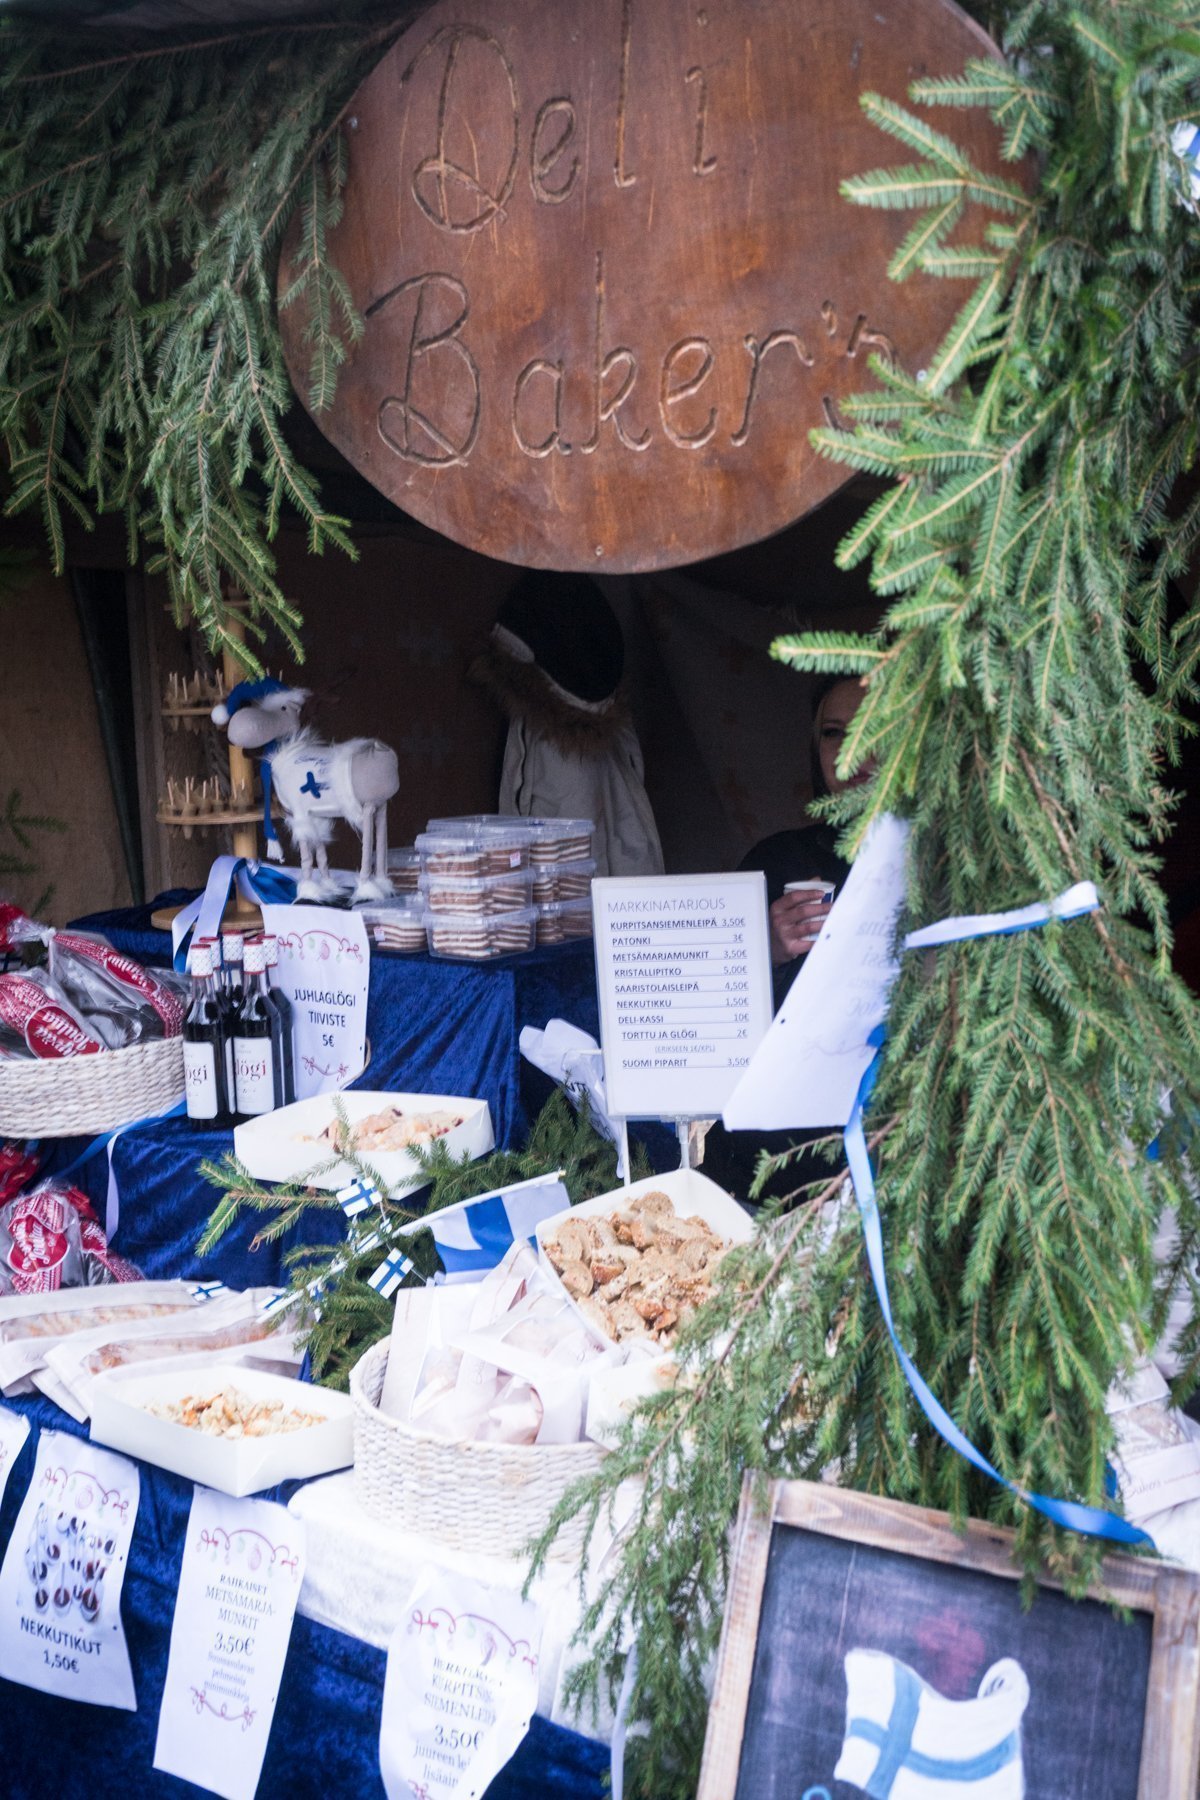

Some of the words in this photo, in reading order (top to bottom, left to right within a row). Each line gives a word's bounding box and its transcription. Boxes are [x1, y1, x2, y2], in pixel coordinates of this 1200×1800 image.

[400, 0, 717, 234] Deli
[607, 898, 726, 913] MARKKINATARJOUS
[610, 917, 718, 930] KURPITSANSIEMENLEIPÄ
[722, 917, 745, 928] 3,50€
[612, 936, 650, 946] PATONKI
[732, 934, 744, 943] 3€
[612, 950, 710, 961] METSÄMARJAMUNKIT
[723, 949, 748, 960] 3,50€
[614, 967, 682, 977] KRISTALLIPITKO
[723, 965, 748, 976] 5,00€
[614, 981, 700, 993] SAARISTOLAISLEIPÄ
[725, 981, 748, 992] 4,50€
[294, 989, 356, 1007] JUHLAGLÖGI
[616, 999, 672, 1009] NEKKUTIKKU
[726, 998, 749, 1008] 1,50€
[308, 1010, 346, 1028] TIIVISTE
[618, 1014, 664, 1024] DELI-KASSI
[734, 1012, 750, 1022] 10€
[322, 1034, 334, 1047] 5€
[622, 1030, 656, 1040] TORTTU
[658, 1030, 668, 1040] JA
[670, 1028, 698, 1039] GLÖGI
[736, 1029, 748, 1038] 2€
[622, 1059, 652, 1068] SUOMI
[654, 1058, 688, 1068] PIPARIT
[727, 1057, 750, 1067] 3,50€
[220, 1574, 267, 1595] RAHKAISET
[218, 1608, 259, 1630] MUNKIT
[20, 1616, 102, 1655] NEKKUTIKUT
[44, 1649, 79, 1674] 1,50€
